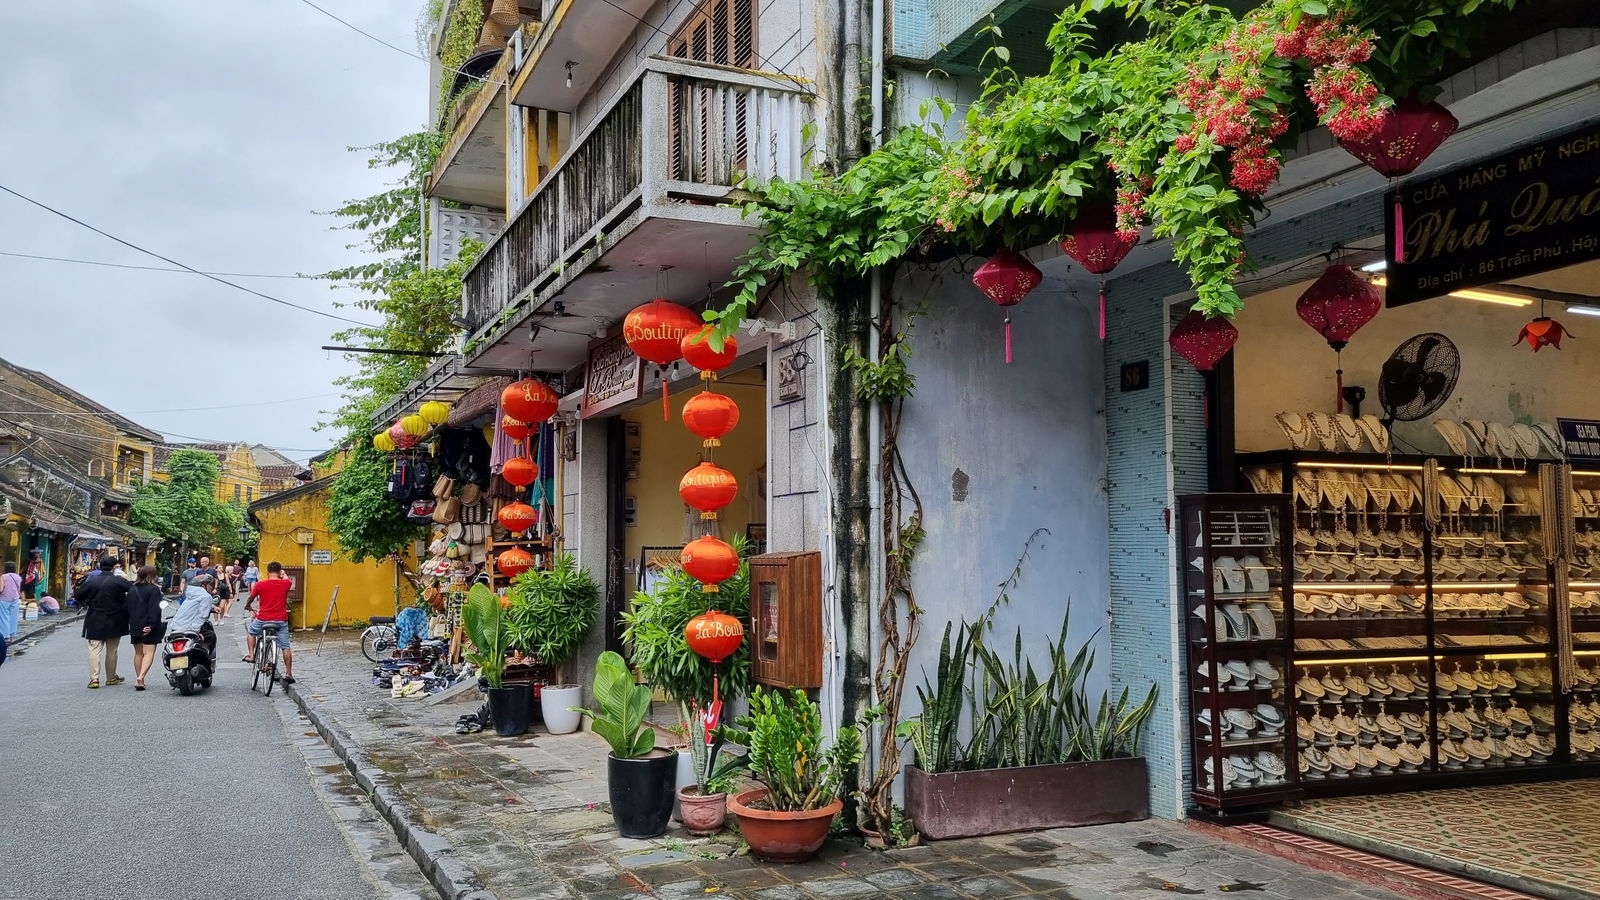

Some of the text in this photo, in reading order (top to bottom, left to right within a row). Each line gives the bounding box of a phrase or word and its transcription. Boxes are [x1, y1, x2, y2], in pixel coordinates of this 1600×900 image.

[1402, 200, 1492, 265] Phú
[1478, 259, 1495, 275] 86
[1497, 248, 1532, 270] Trần
[628, 312, 688, 345] Boutiqu
[779, 357, 796, 384] 88
[1125, 367, 1141, 387] 86
[522, 382, 540, 402] La
[695, 620, 711, 640] La
